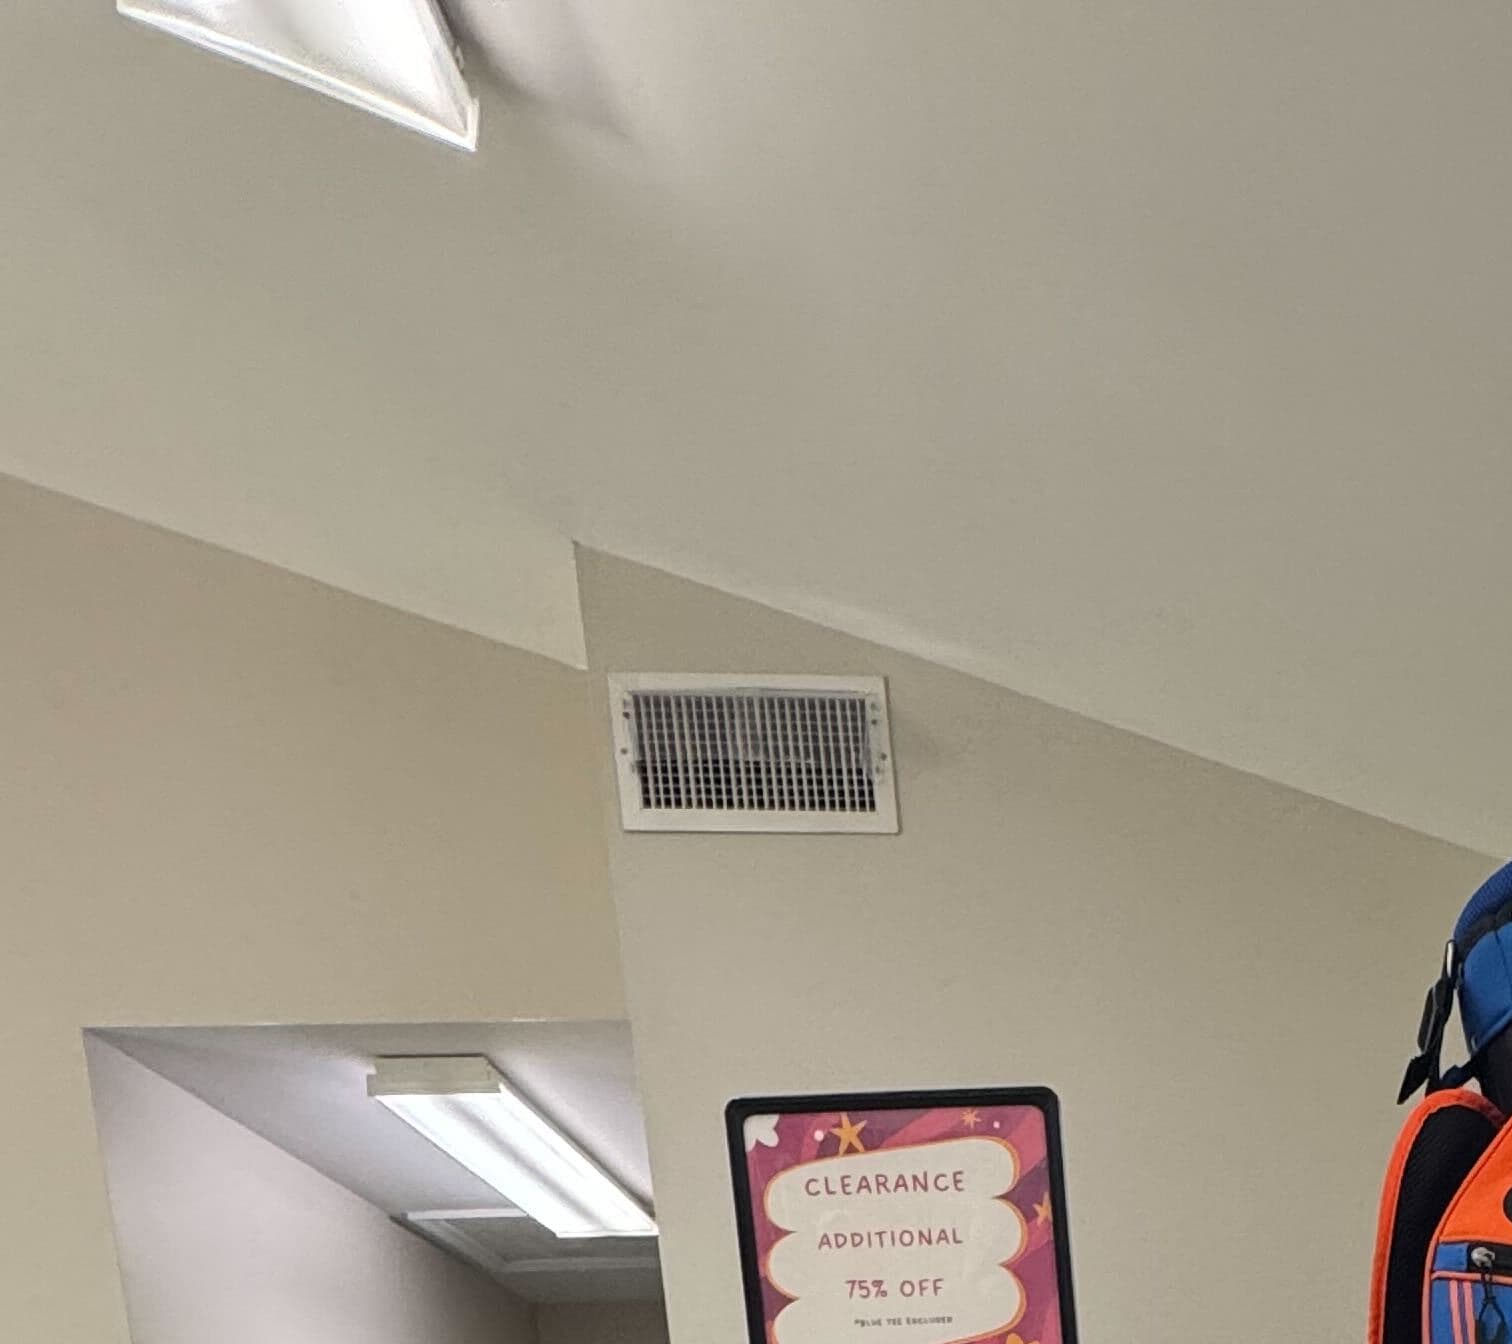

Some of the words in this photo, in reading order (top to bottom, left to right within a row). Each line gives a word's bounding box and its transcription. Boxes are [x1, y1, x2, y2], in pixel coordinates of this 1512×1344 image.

[804, 1170, 966, 1197] CLEARANCE
[818, 1228, 963, 1250] ADDITIONAL
[845, 1279, 888, 1298] 75%
[900, 1278, 945, 1297] OFF
